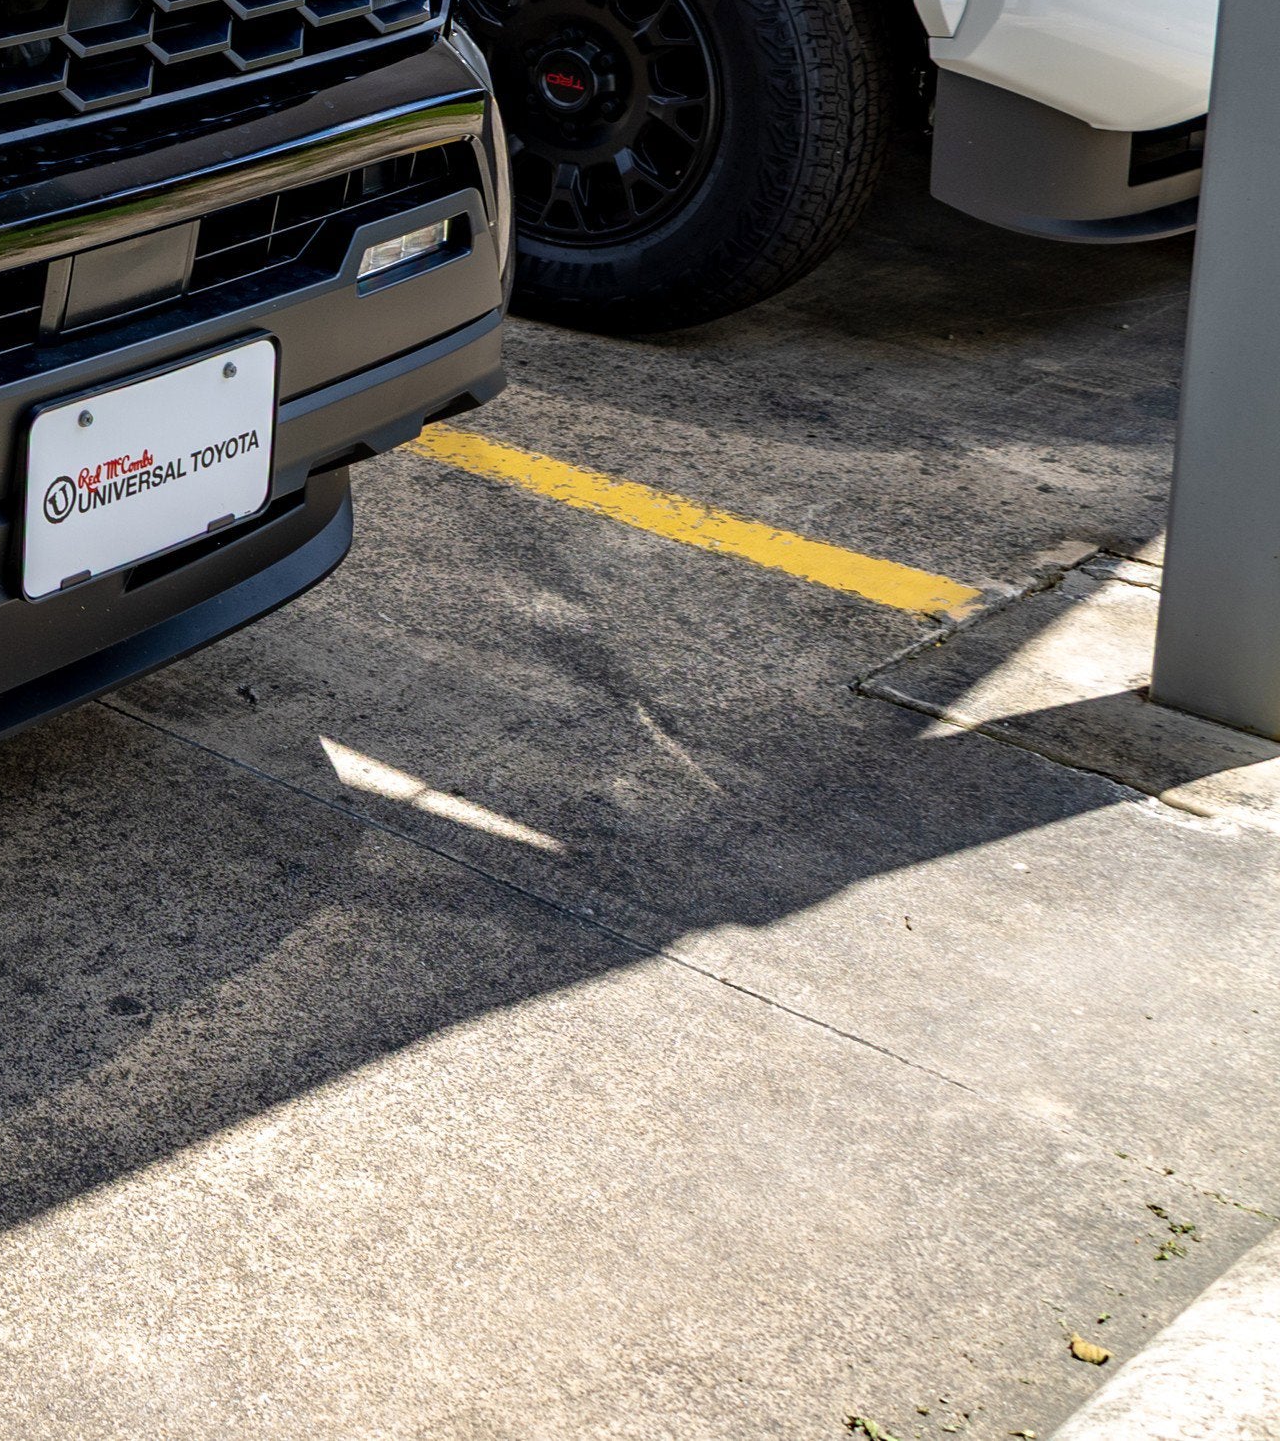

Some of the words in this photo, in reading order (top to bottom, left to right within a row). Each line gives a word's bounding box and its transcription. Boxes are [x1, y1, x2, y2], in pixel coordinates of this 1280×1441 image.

[546, 73, 585, 91] TRD
[78, 458, 187, 513] UNIVERSAL
[190, 430, 259, 472] TOYOTA
[78, 465, 101, 493] Red
